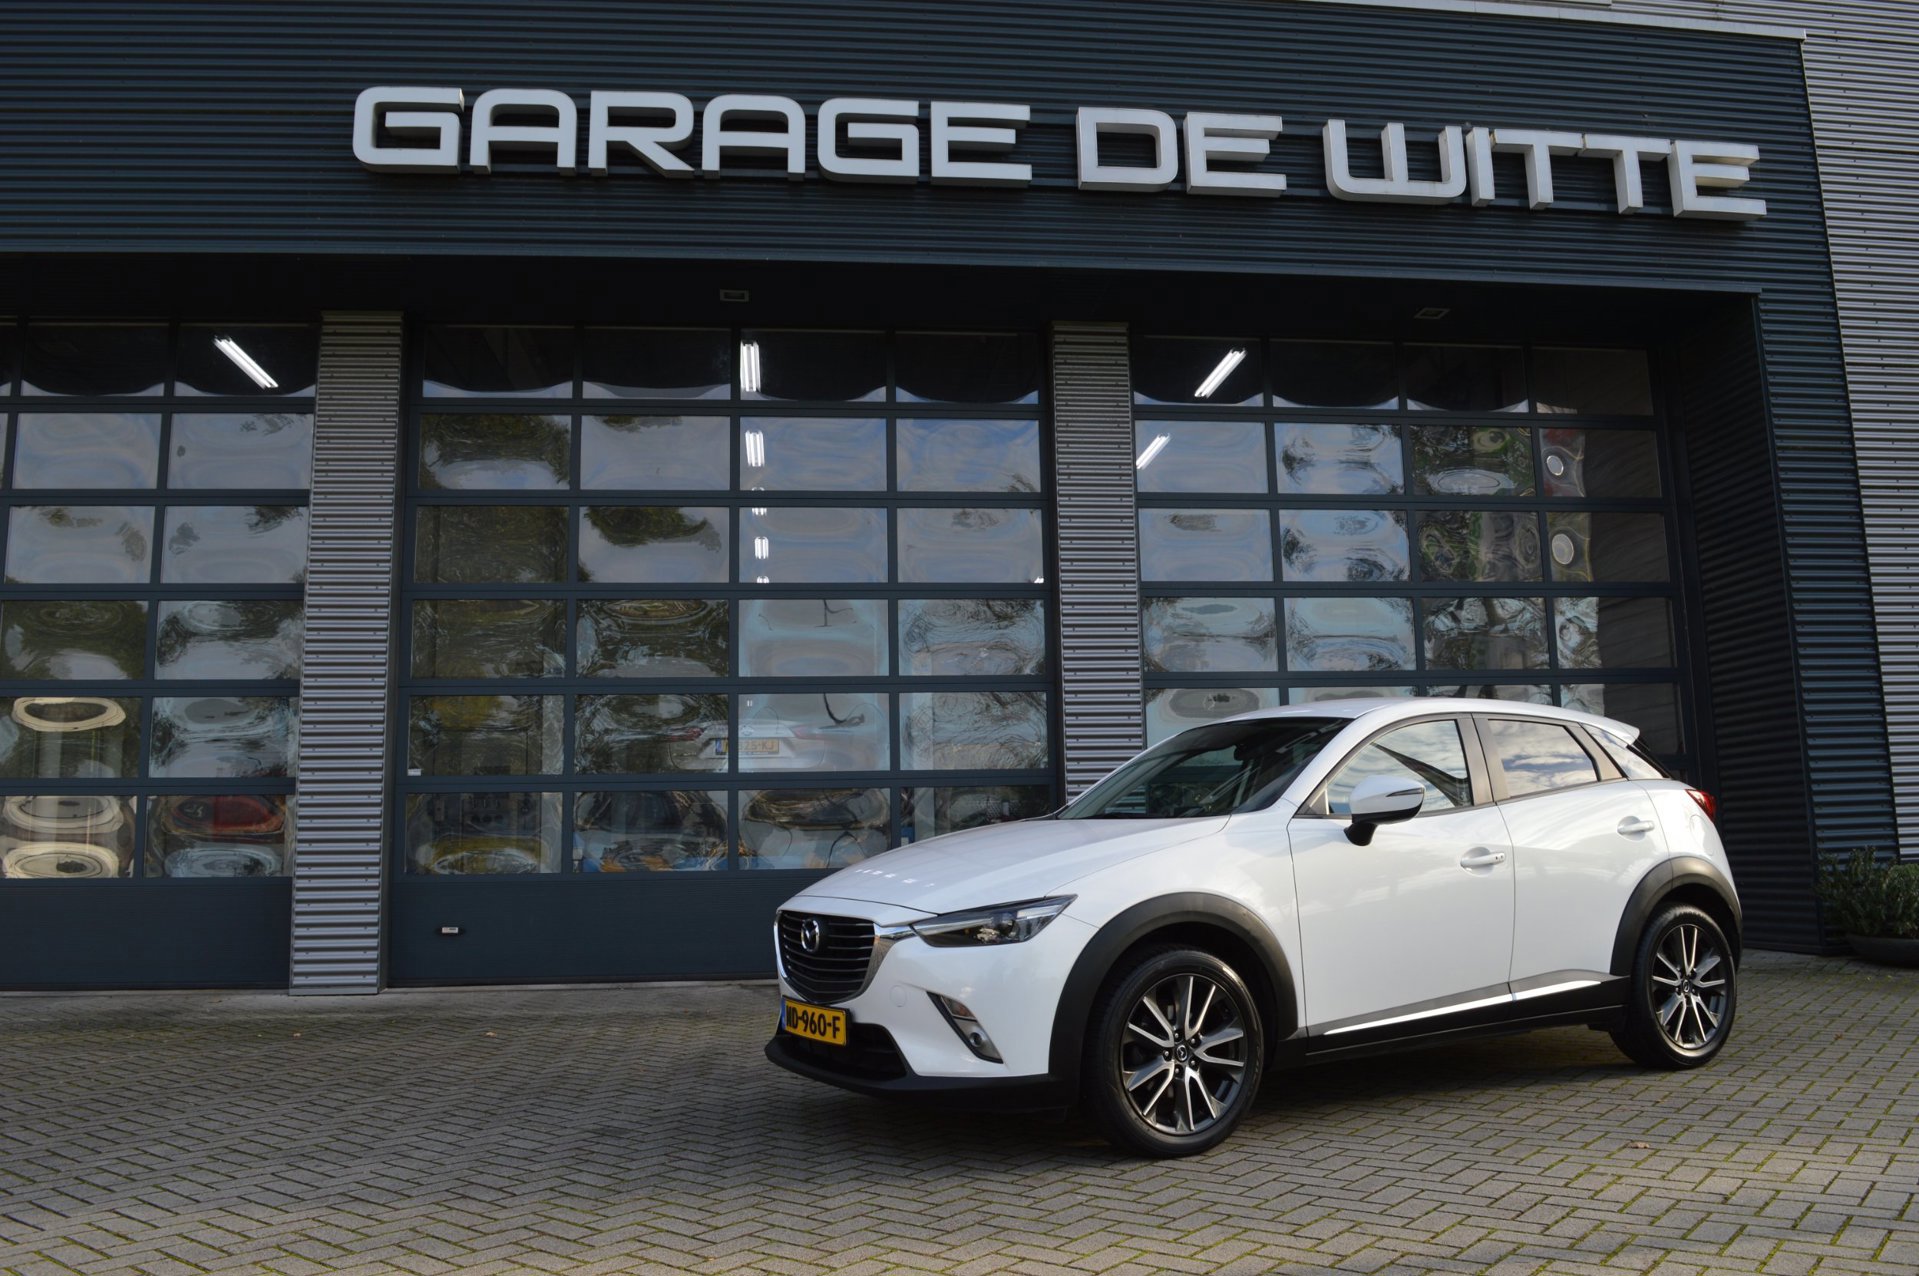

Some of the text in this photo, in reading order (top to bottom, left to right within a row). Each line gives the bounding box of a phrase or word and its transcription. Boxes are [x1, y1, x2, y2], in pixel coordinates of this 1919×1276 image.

[352, 86, 1767, 219] GARAGE DE WITTE
